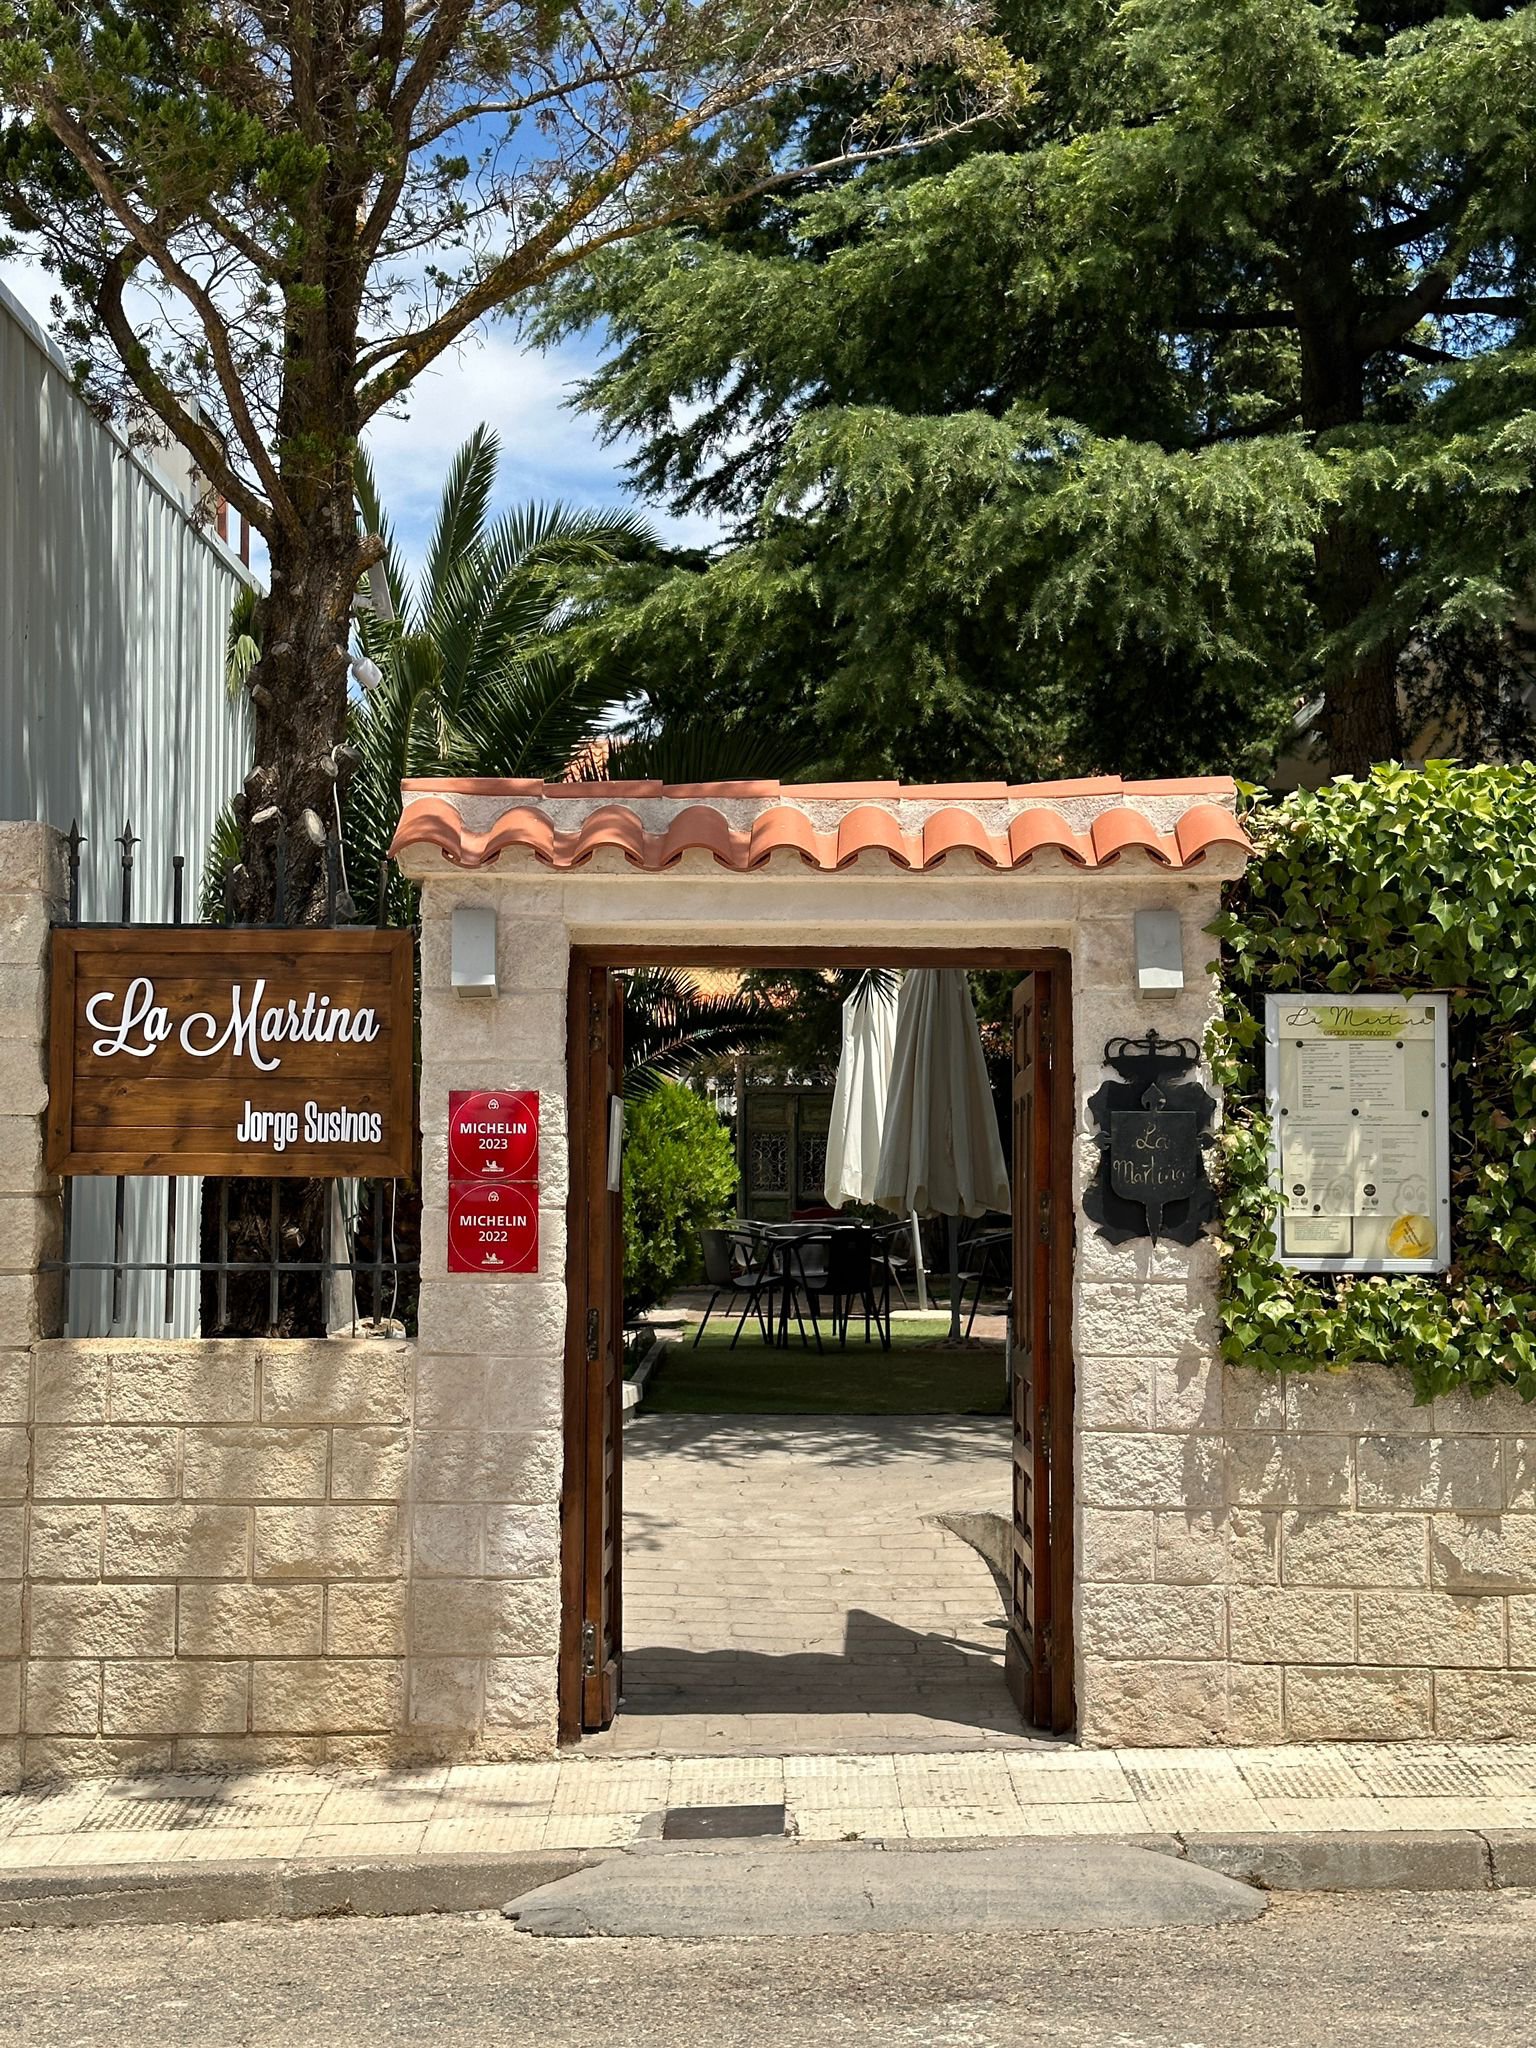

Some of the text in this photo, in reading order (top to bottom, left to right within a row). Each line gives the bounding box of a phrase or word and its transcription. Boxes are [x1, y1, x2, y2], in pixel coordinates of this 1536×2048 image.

[86, 977, 380, 1071] La Martina
[1286, 1006, 1432, 1026] La Martina
[237, 1101, 382, 1151] Jorge Susinos
[460, 1123, 527, 1134] MICHELIN
[478, 1138, 508, 1149] 2023
[1136, 1124, 1169, 1150] La
[459, 1215, 527, 1227] MICHELIN
[478, 1230, 508, 1242] 2022
